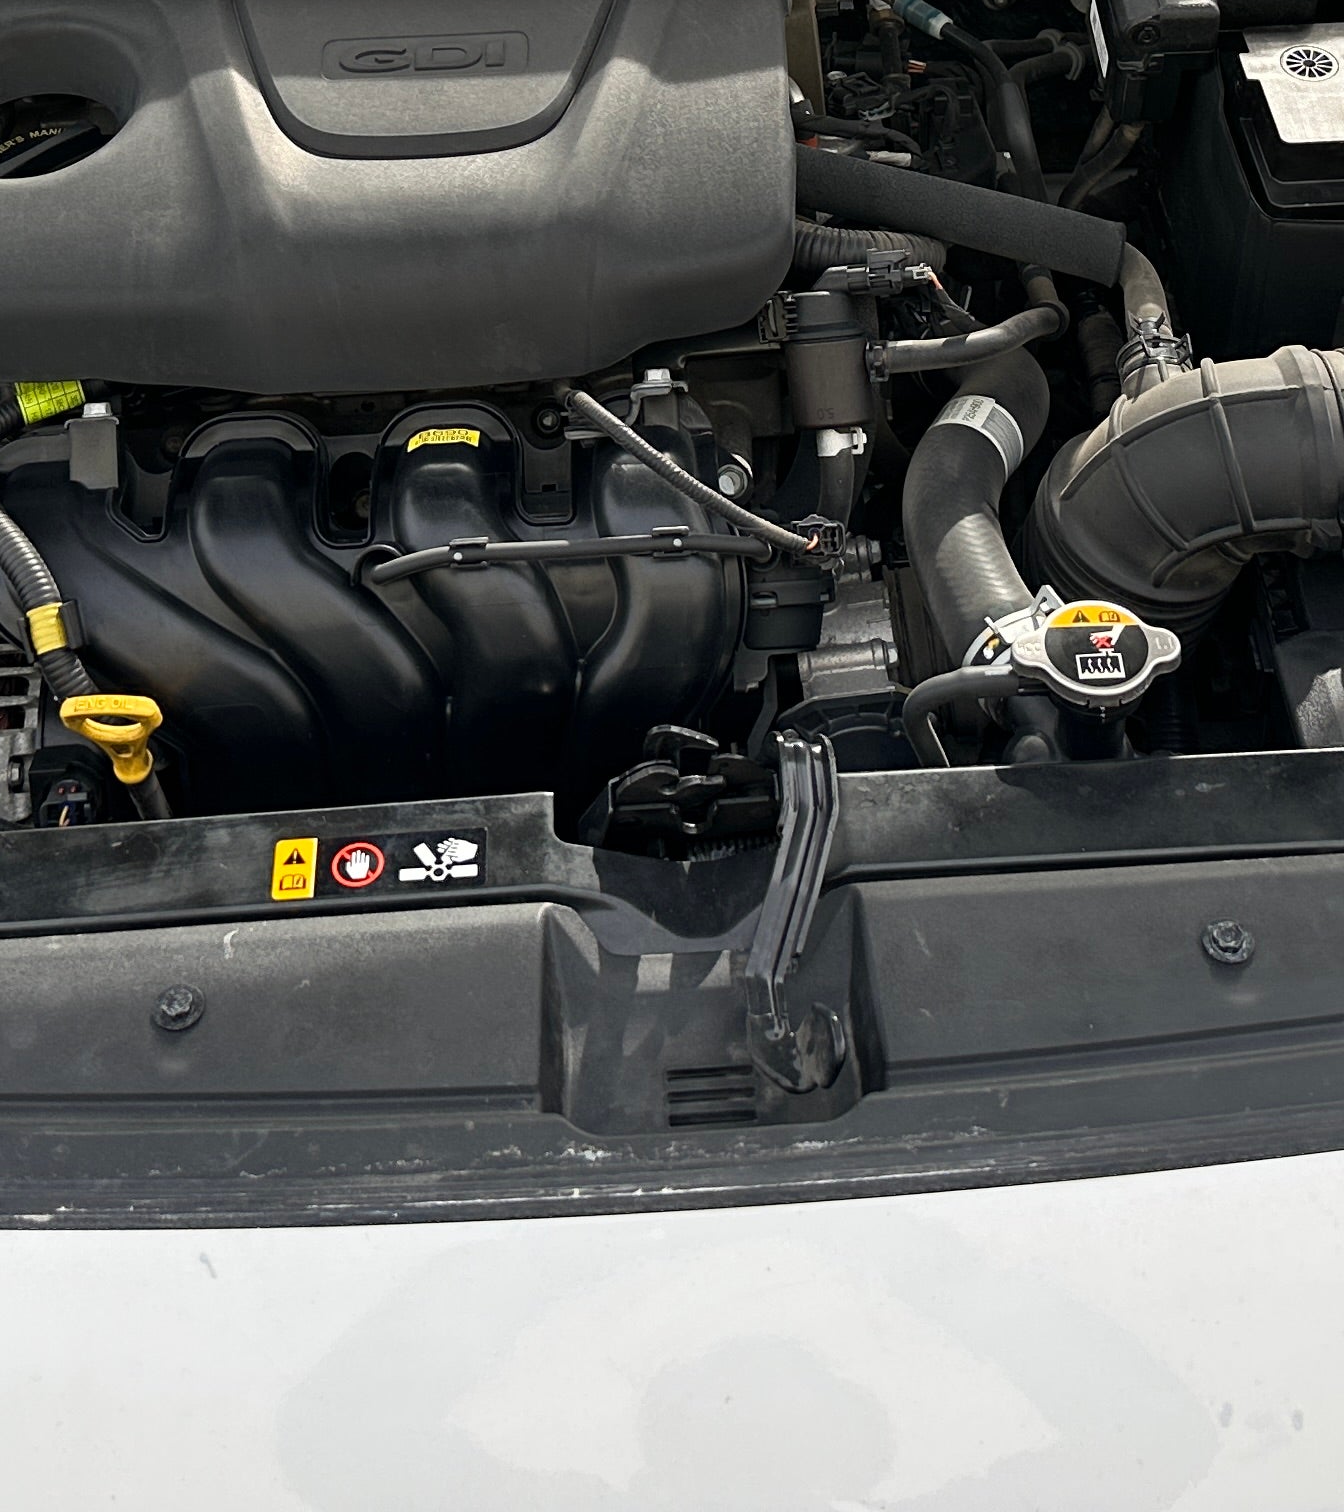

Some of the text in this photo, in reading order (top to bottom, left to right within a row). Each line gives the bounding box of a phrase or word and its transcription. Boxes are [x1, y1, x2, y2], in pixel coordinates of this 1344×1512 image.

[339, 40, 506, 74] GDI
[75, 698, 133, 711] ENG OIL
